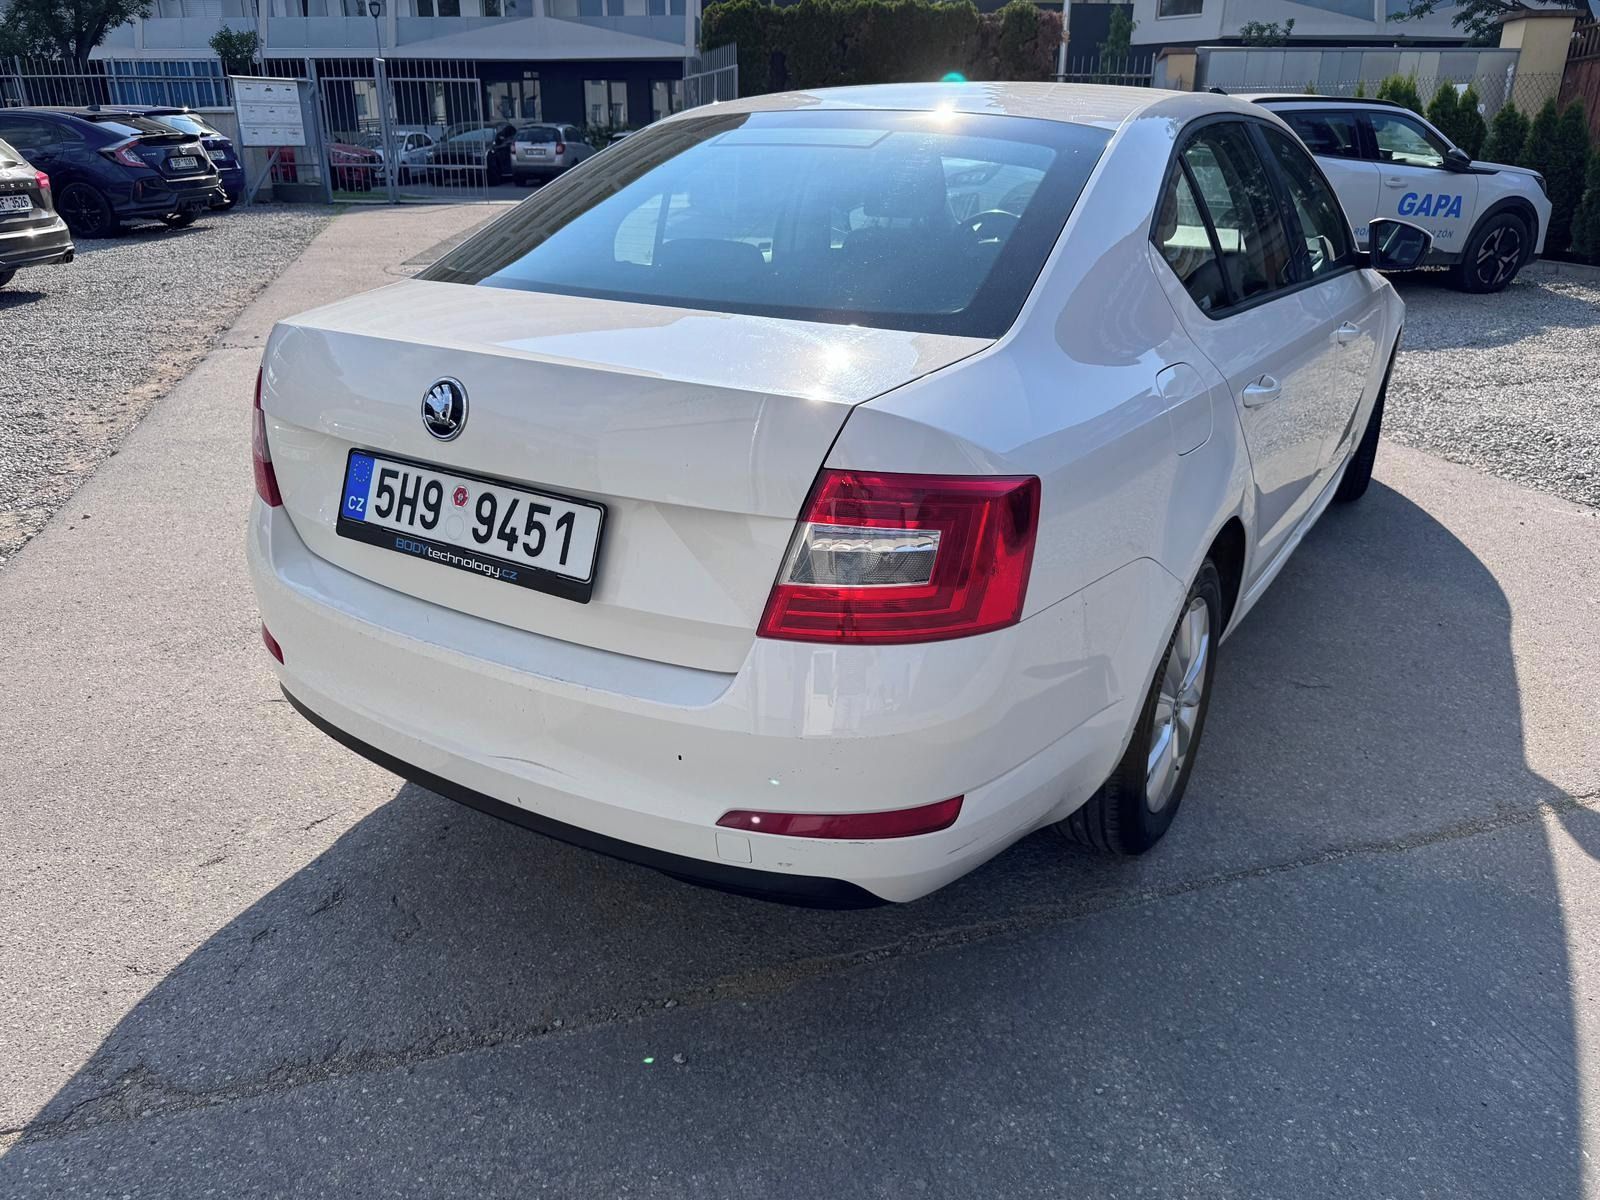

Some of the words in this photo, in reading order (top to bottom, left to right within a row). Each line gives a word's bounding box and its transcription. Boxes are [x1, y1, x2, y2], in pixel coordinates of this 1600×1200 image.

[1397, 192, 1462, 218] GAPA
[348, 495, 365, 512] CZ
[374, 467, 444, 530] 5H9
[471, 492, 576, 566] 9451
[395, 537, 518, 579] BODYtechnology.cz
